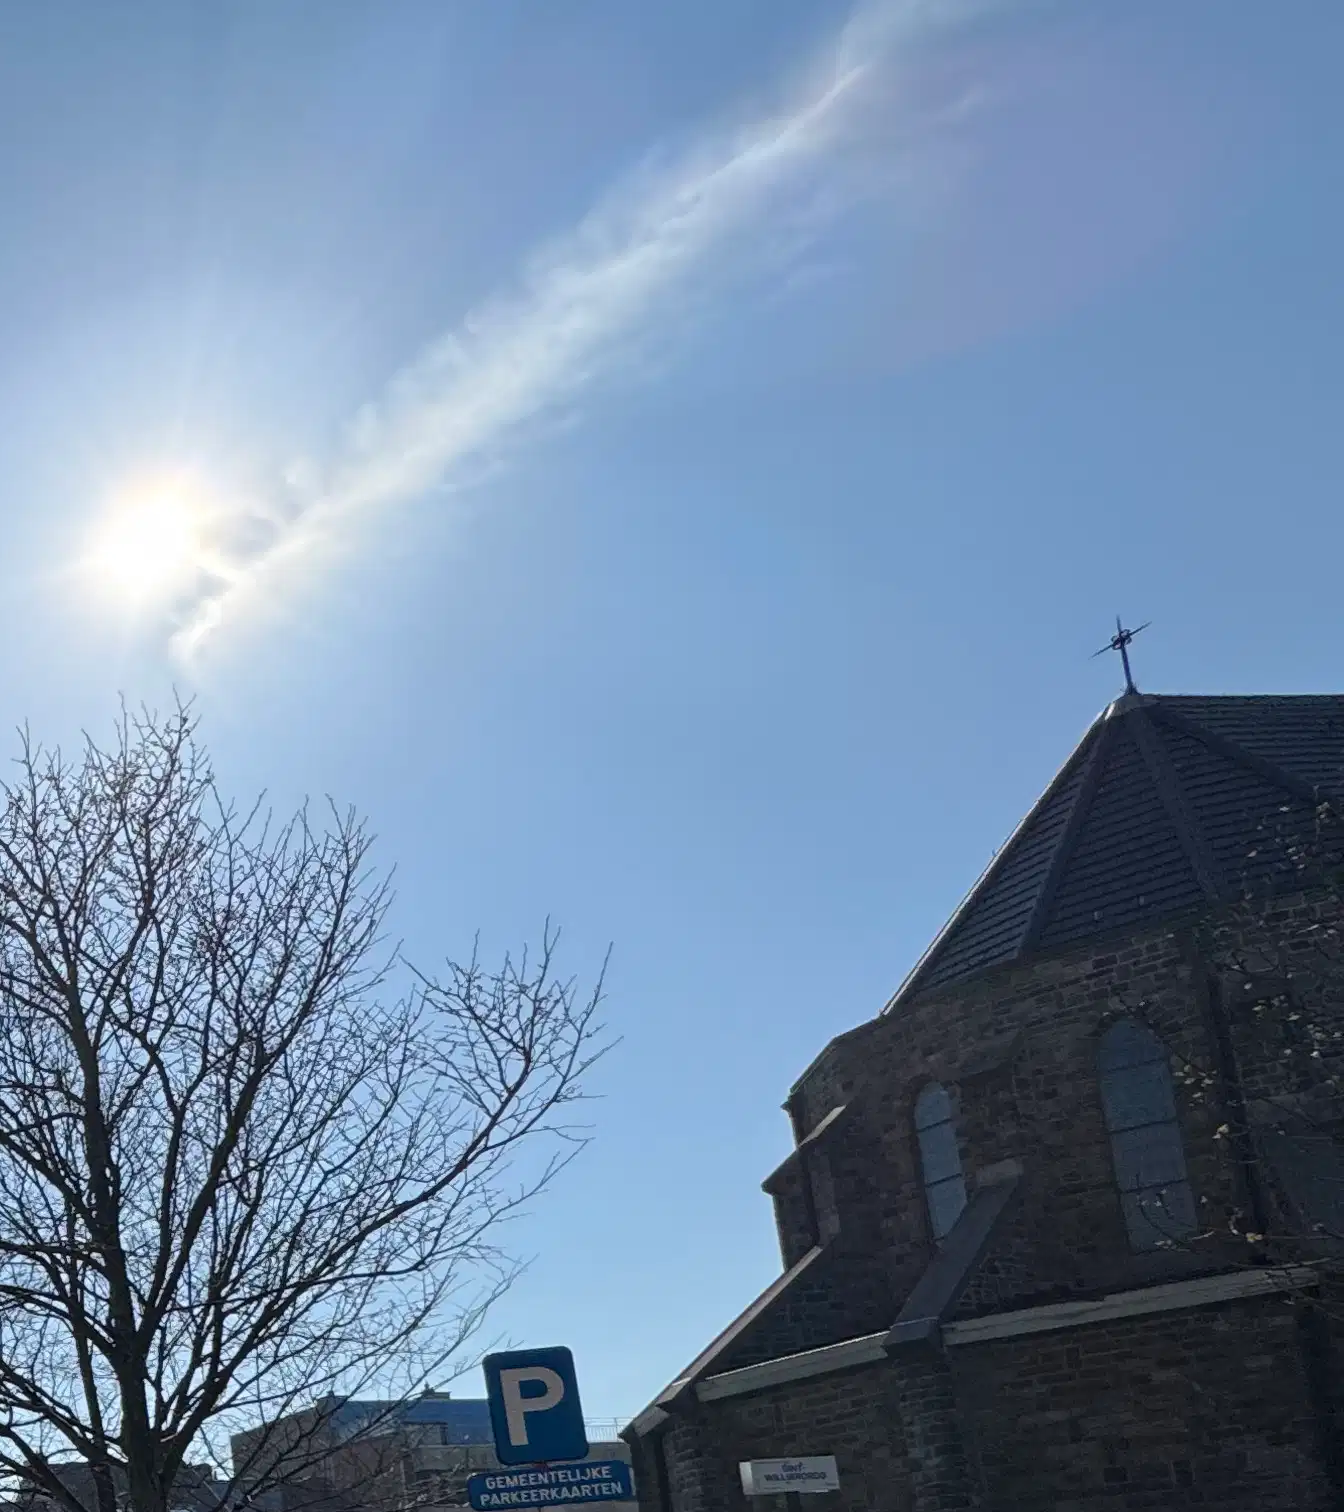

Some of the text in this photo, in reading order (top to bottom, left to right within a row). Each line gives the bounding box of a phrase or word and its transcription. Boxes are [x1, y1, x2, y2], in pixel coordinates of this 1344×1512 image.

[499, 1366, 565, 1447] P
[485, 1465, 613, 1490] GEMEENTELIJKE
[480, 1481, 624, 1506] PARKEERKAARTEN
